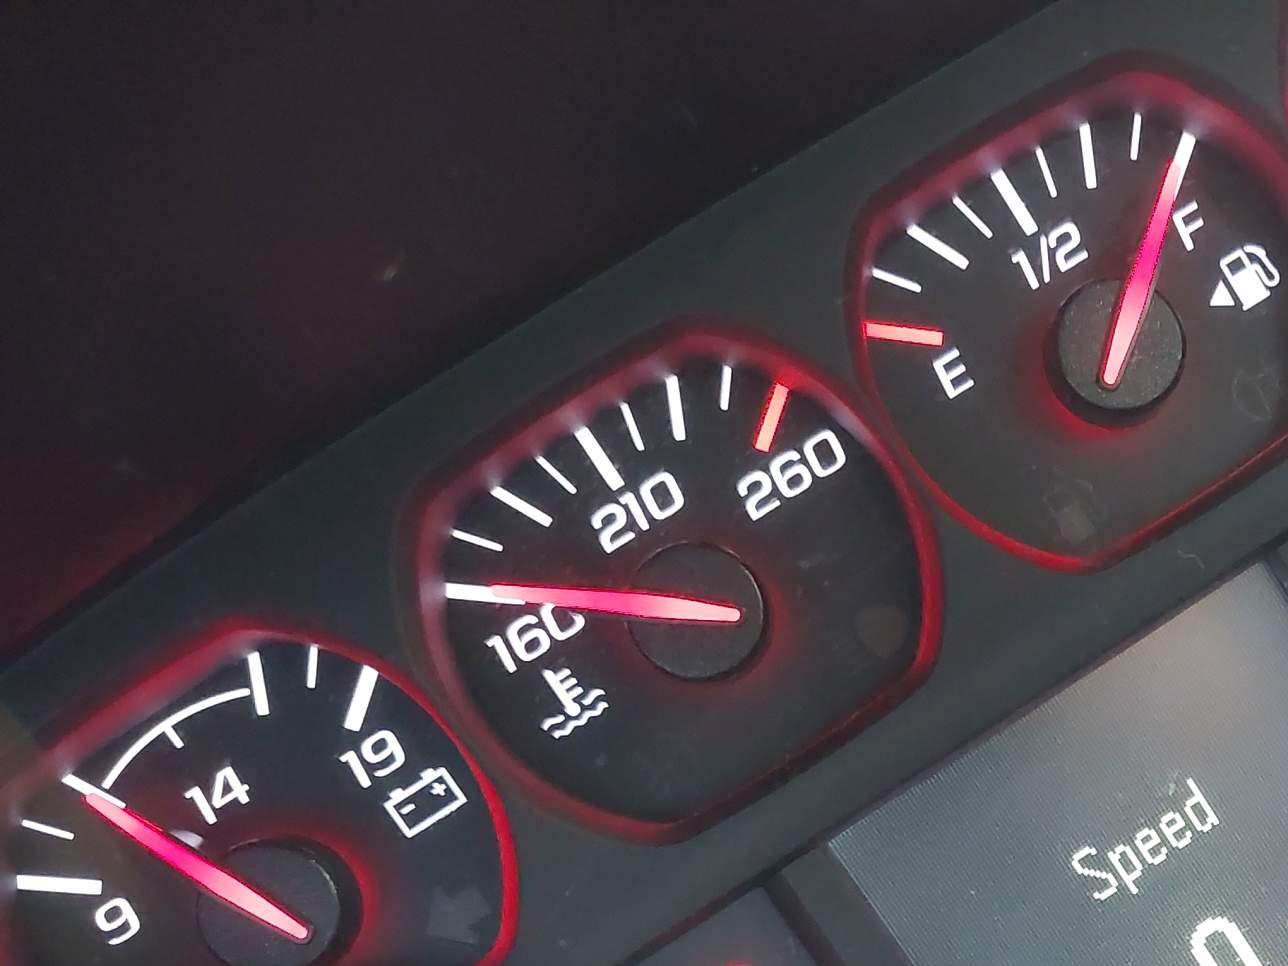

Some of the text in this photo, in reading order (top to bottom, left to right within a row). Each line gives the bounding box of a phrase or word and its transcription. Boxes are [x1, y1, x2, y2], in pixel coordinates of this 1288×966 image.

[1011, 222, 1089, 289] 1/2
[1173, 201, 1204, 251] F
[933, 348, 974, 399] E
[737, 429, 846, 521] 260
[591, 471, 685, 553] 210
[339, 729, 408, 789] 19
[184, 766, 251, 825] 14
[1071, 778, 1220, 900] Speed
[95, 897, 141, 945] 9
